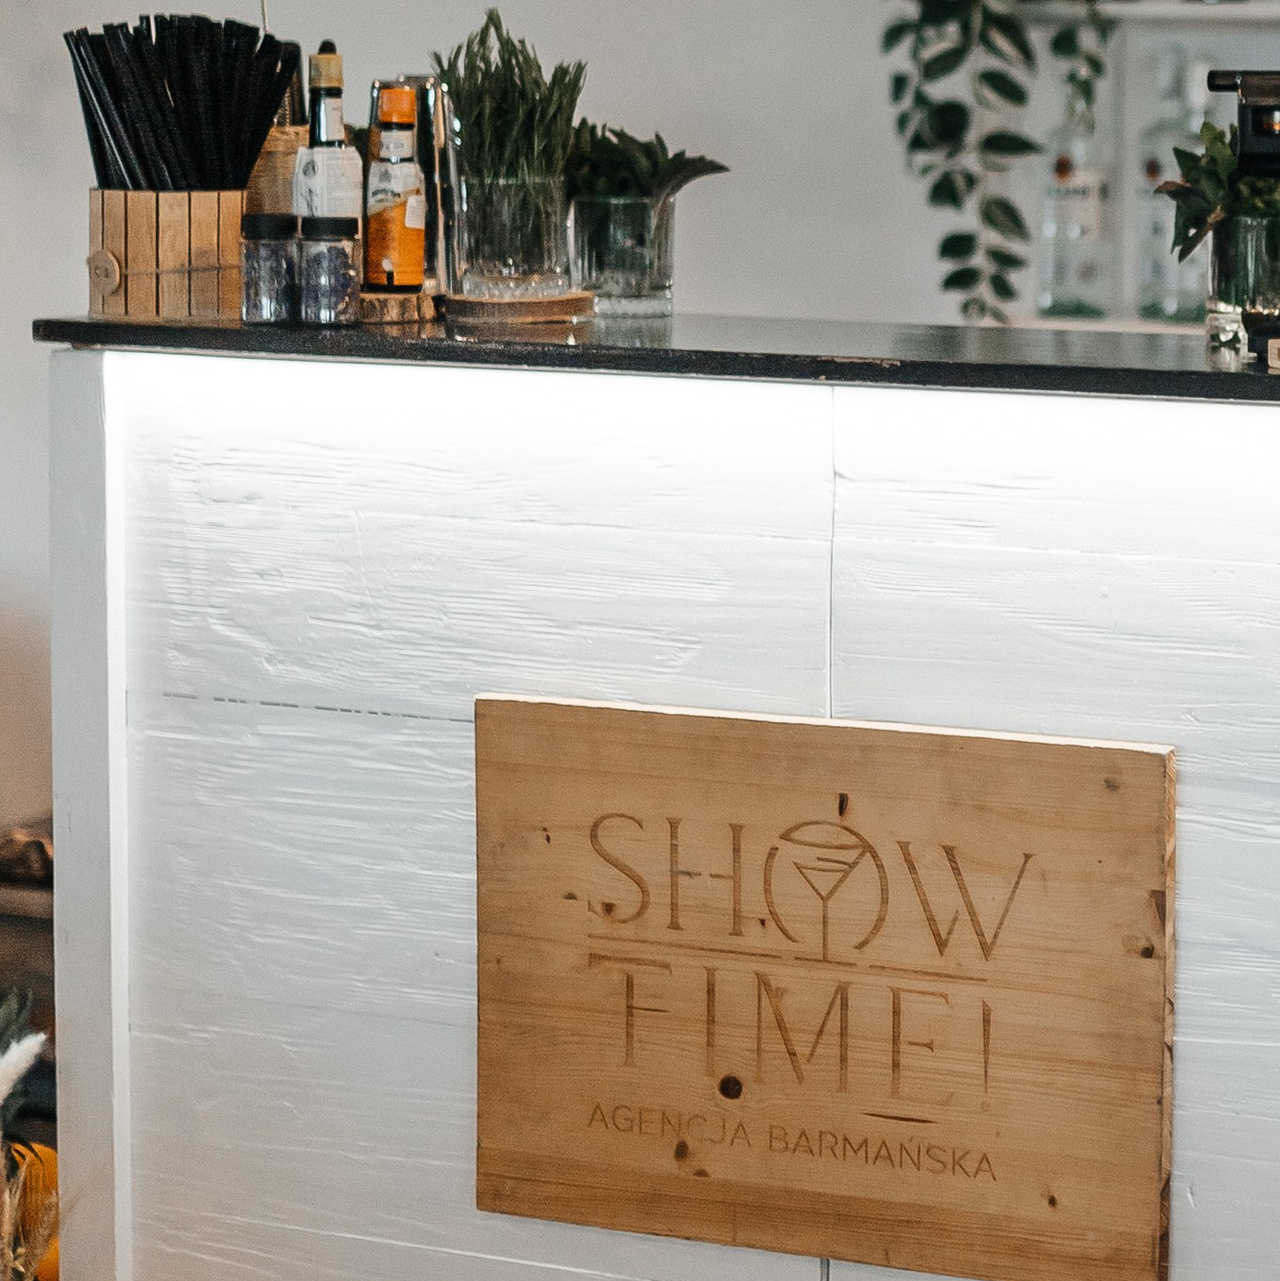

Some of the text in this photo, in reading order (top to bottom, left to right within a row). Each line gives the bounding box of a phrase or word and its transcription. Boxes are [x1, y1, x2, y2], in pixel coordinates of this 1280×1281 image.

[587, 812, 1036, 962] SHOW
[587, 1104, 998, 1183] AGENCJA BARMAŃSKA
